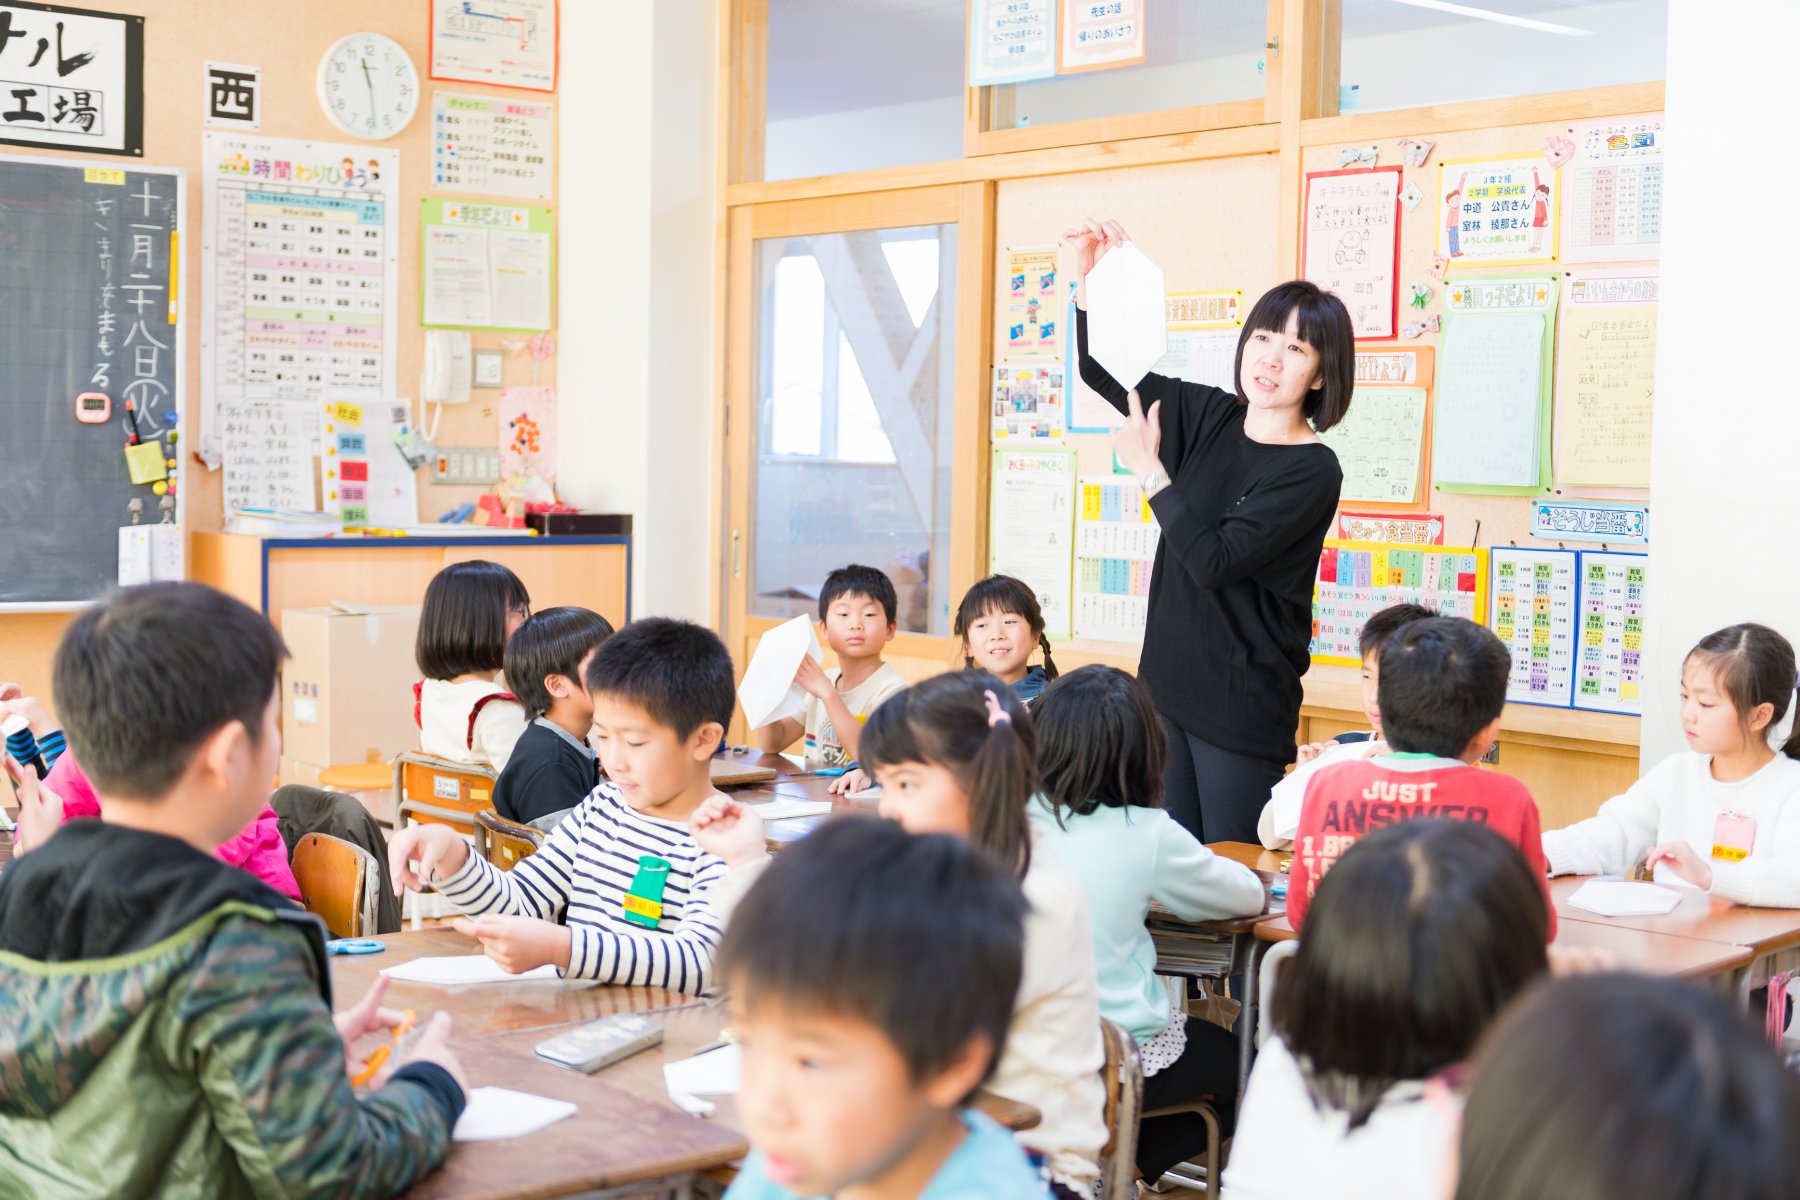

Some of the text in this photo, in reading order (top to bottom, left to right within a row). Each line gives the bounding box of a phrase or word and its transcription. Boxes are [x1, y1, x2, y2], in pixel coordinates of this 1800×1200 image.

[1091, 3, 1121, 17] 先生の話
[1079, 25, 1132, 42] 帰りのあいさつ
[209, 69, 256, 121] 西
[3, 88, 98, 132] 工場
[253, 158, 367, 189] 時間わりひょう
[1483, 175, 1512, 184] 3年2組
[1468, 185, 1527, 197] 2学期 学級代表
[1462, 200, 1530, 213] 中道 公貴さん
[1462, 220, 1482, 232] 室林
[1553, 509, 1627, 534] そうじ当番
[1351, 521, 1428, 544] きゅう食当番
[1363, 780, 1438, 803] JUST
